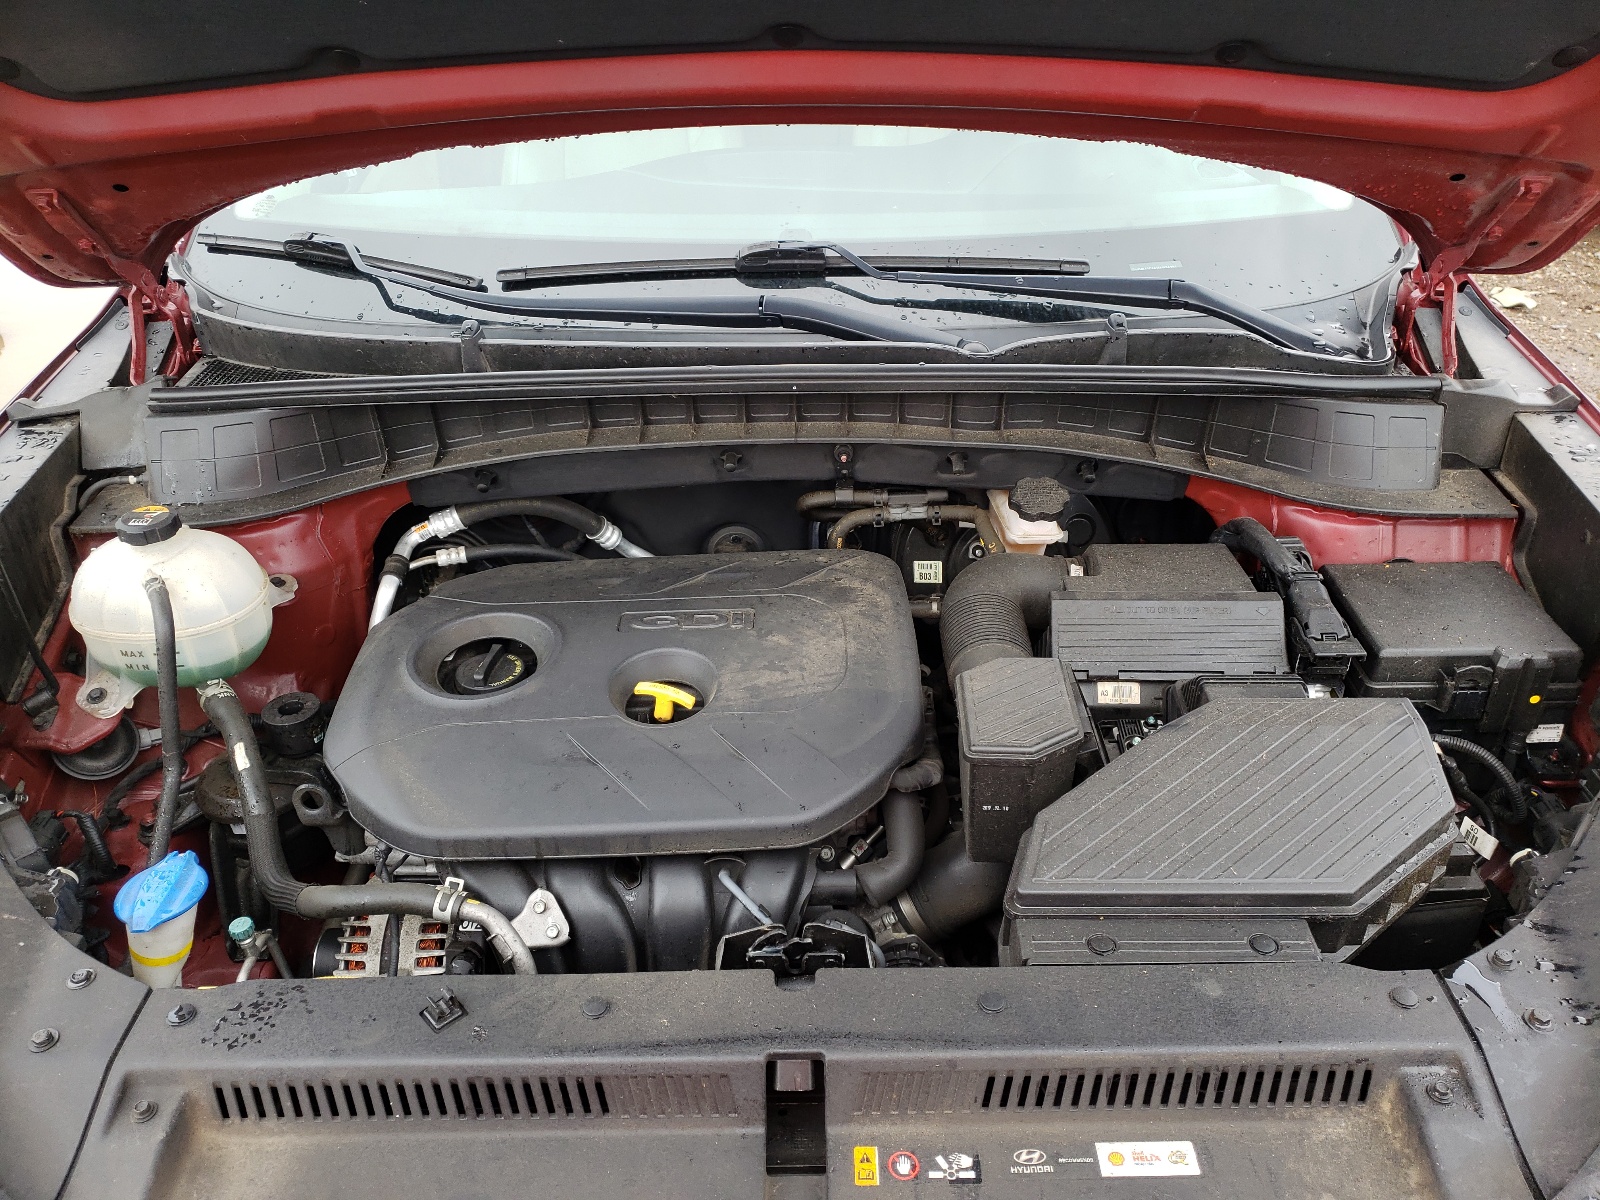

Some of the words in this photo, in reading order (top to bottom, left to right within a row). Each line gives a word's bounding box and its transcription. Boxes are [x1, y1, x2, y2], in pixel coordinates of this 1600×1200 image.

[119, 649, 145, 658] MAX
[125, 663, 151, 671] MIN
[1010, 1165, 1054, 1174] HYUNDAI
